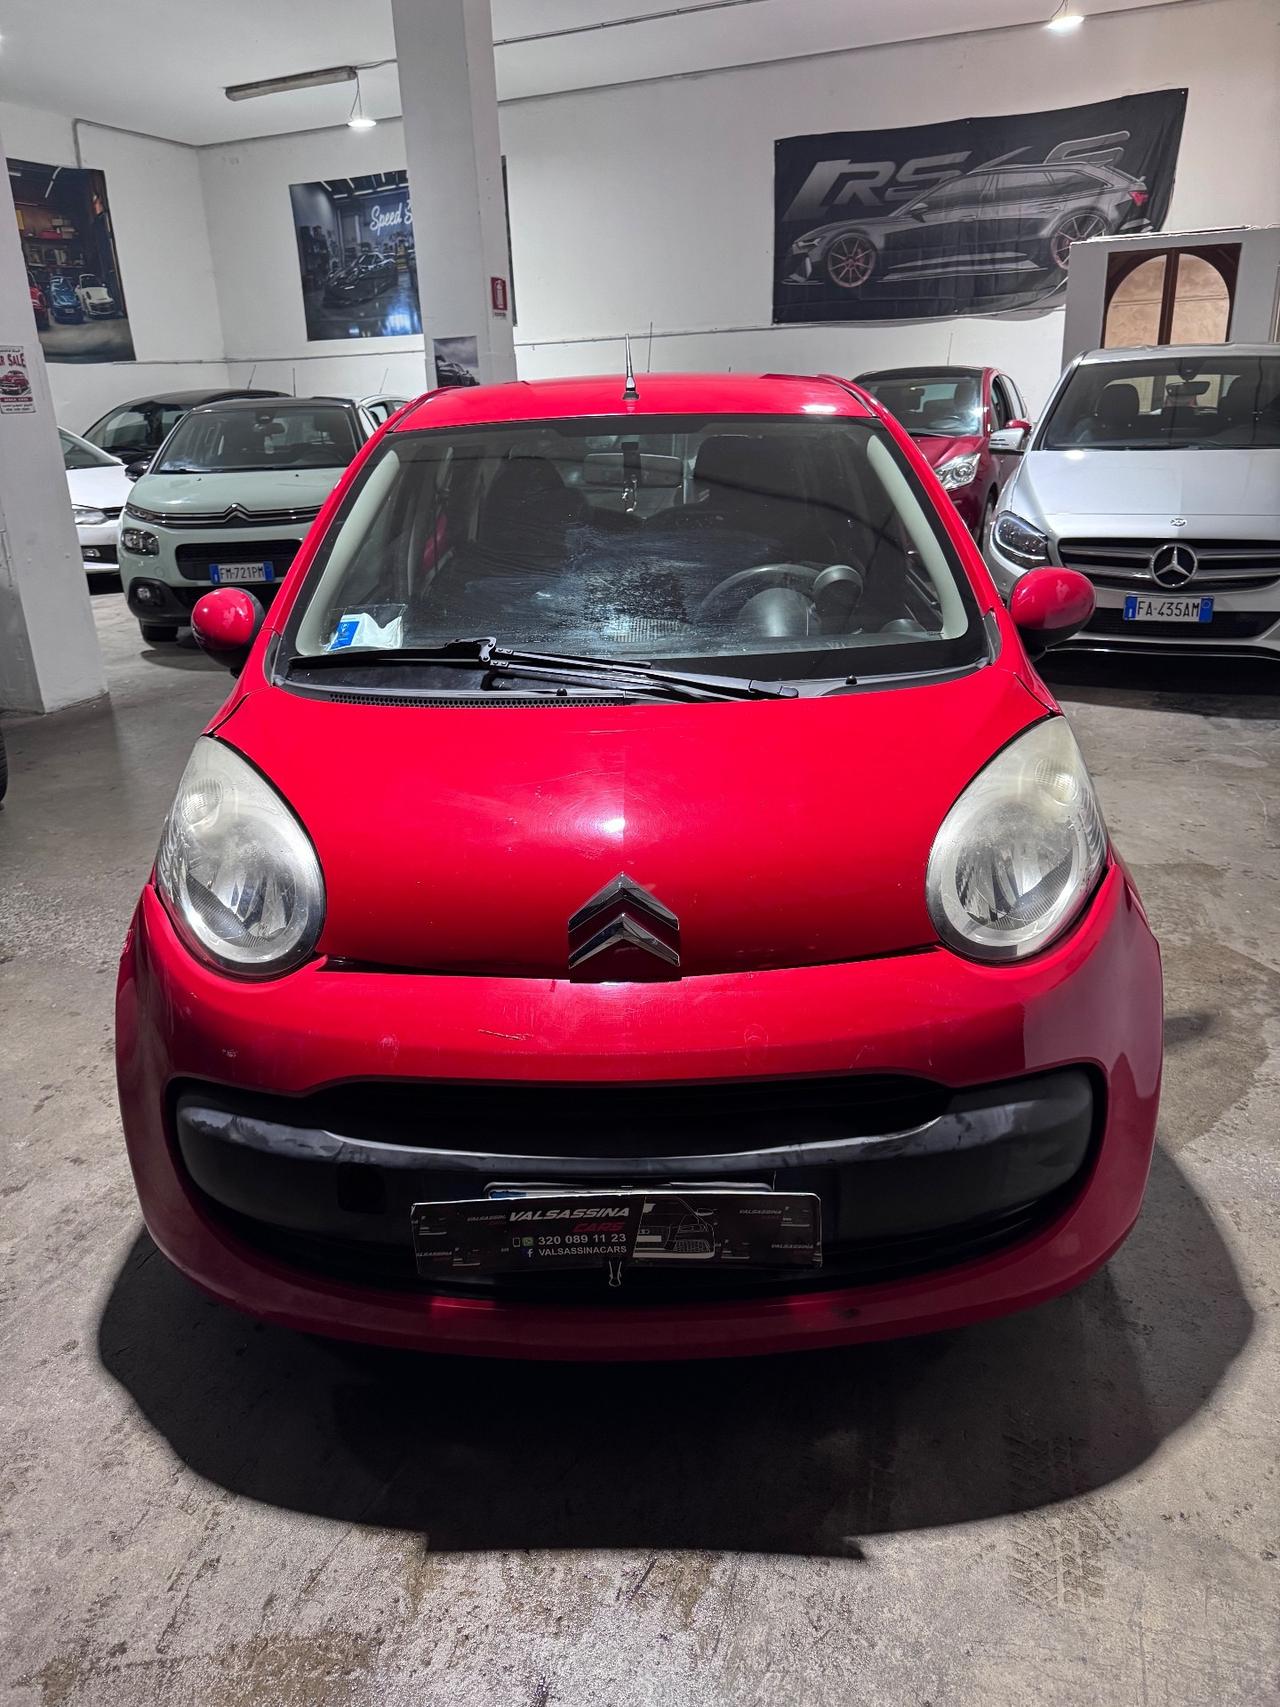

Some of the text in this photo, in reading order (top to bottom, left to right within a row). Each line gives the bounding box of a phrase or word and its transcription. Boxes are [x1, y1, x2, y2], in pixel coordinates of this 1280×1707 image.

[369, 203, 402, 236] Speed
[7, 353, 26, 368] SALE
[509, 1208, 630, 1222] VALSASSINA
[571, 1221, 625, 1233] CARS
[538, 1233, 627, 1246] 320 089 11 23
[538, 1245, 627, 1257] VALSASSINACARS
